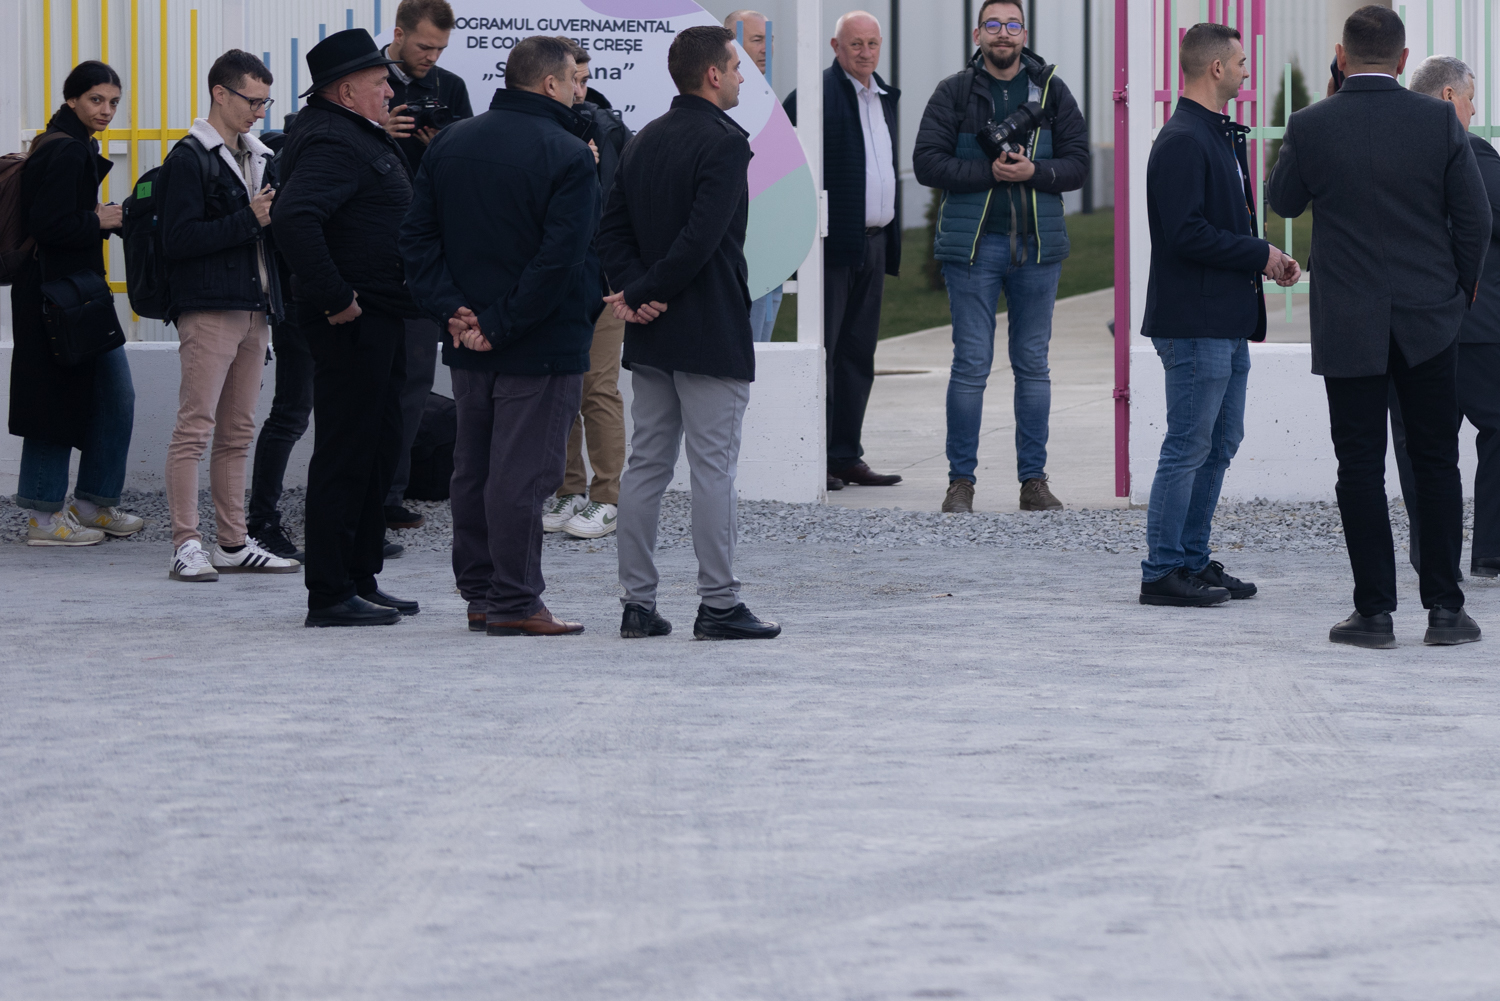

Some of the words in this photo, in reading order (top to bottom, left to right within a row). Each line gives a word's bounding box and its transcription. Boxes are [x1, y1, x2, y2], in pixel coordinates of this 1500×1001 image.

[453, 17, 535, 31] OGRAMUL
[537, 18, 675, 33] GUVERNAMENTAL
[467, 36, 489, 49] DE
[593, 38, 643, 55] CREȘE
